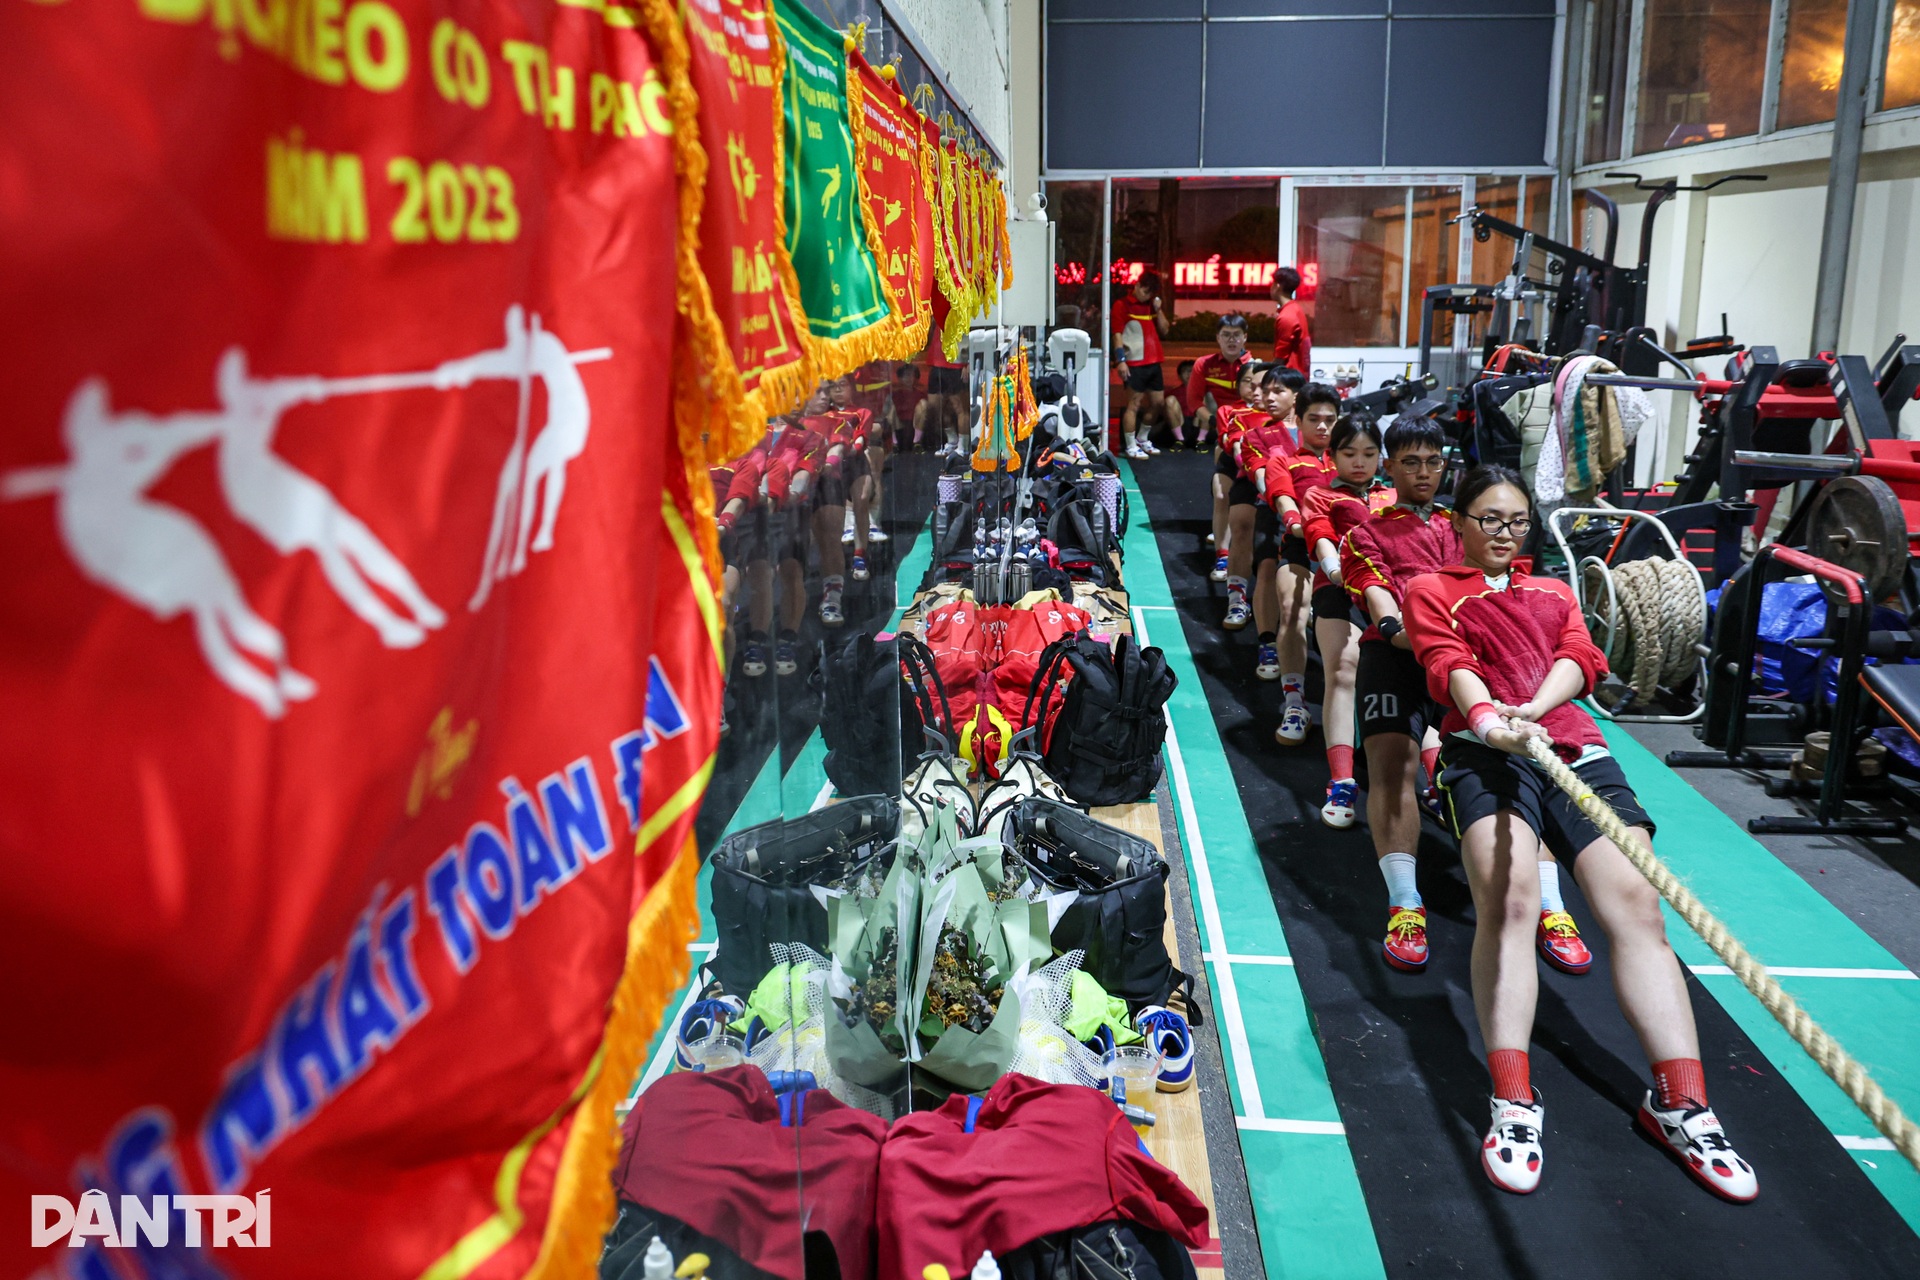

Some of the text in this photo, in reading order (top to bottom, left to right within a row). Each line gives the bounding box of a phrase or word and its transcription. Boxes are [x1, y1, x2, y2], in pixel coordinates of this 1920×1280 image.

[386, 155, 520, 243] 2023
[1225, 262, 1278, 286] THA
[1364, 693, 1398, 722] 20
[426, 756, 613, 976] TOÀN
